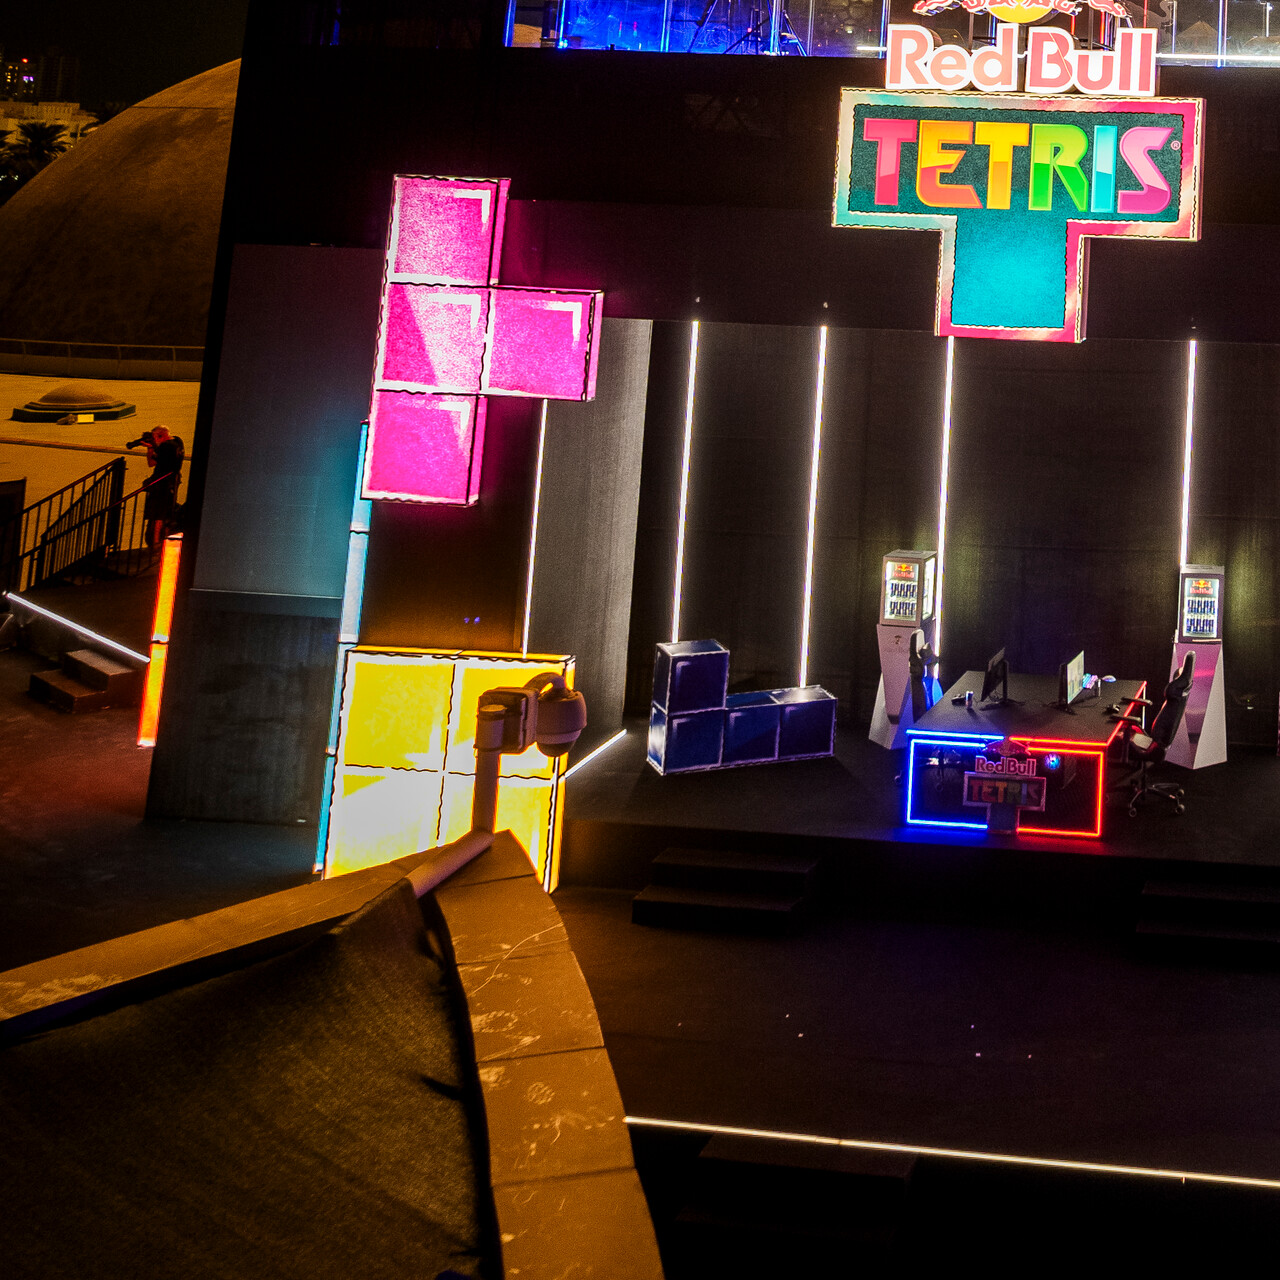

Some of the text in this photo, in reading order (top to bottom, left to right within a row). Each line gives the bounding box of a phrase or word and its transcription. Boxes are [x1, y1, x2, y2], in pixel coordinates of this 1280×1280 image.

[888, 25, 1156, 92] Red Bull
[976, 756, 1036, 776] Red Bull
